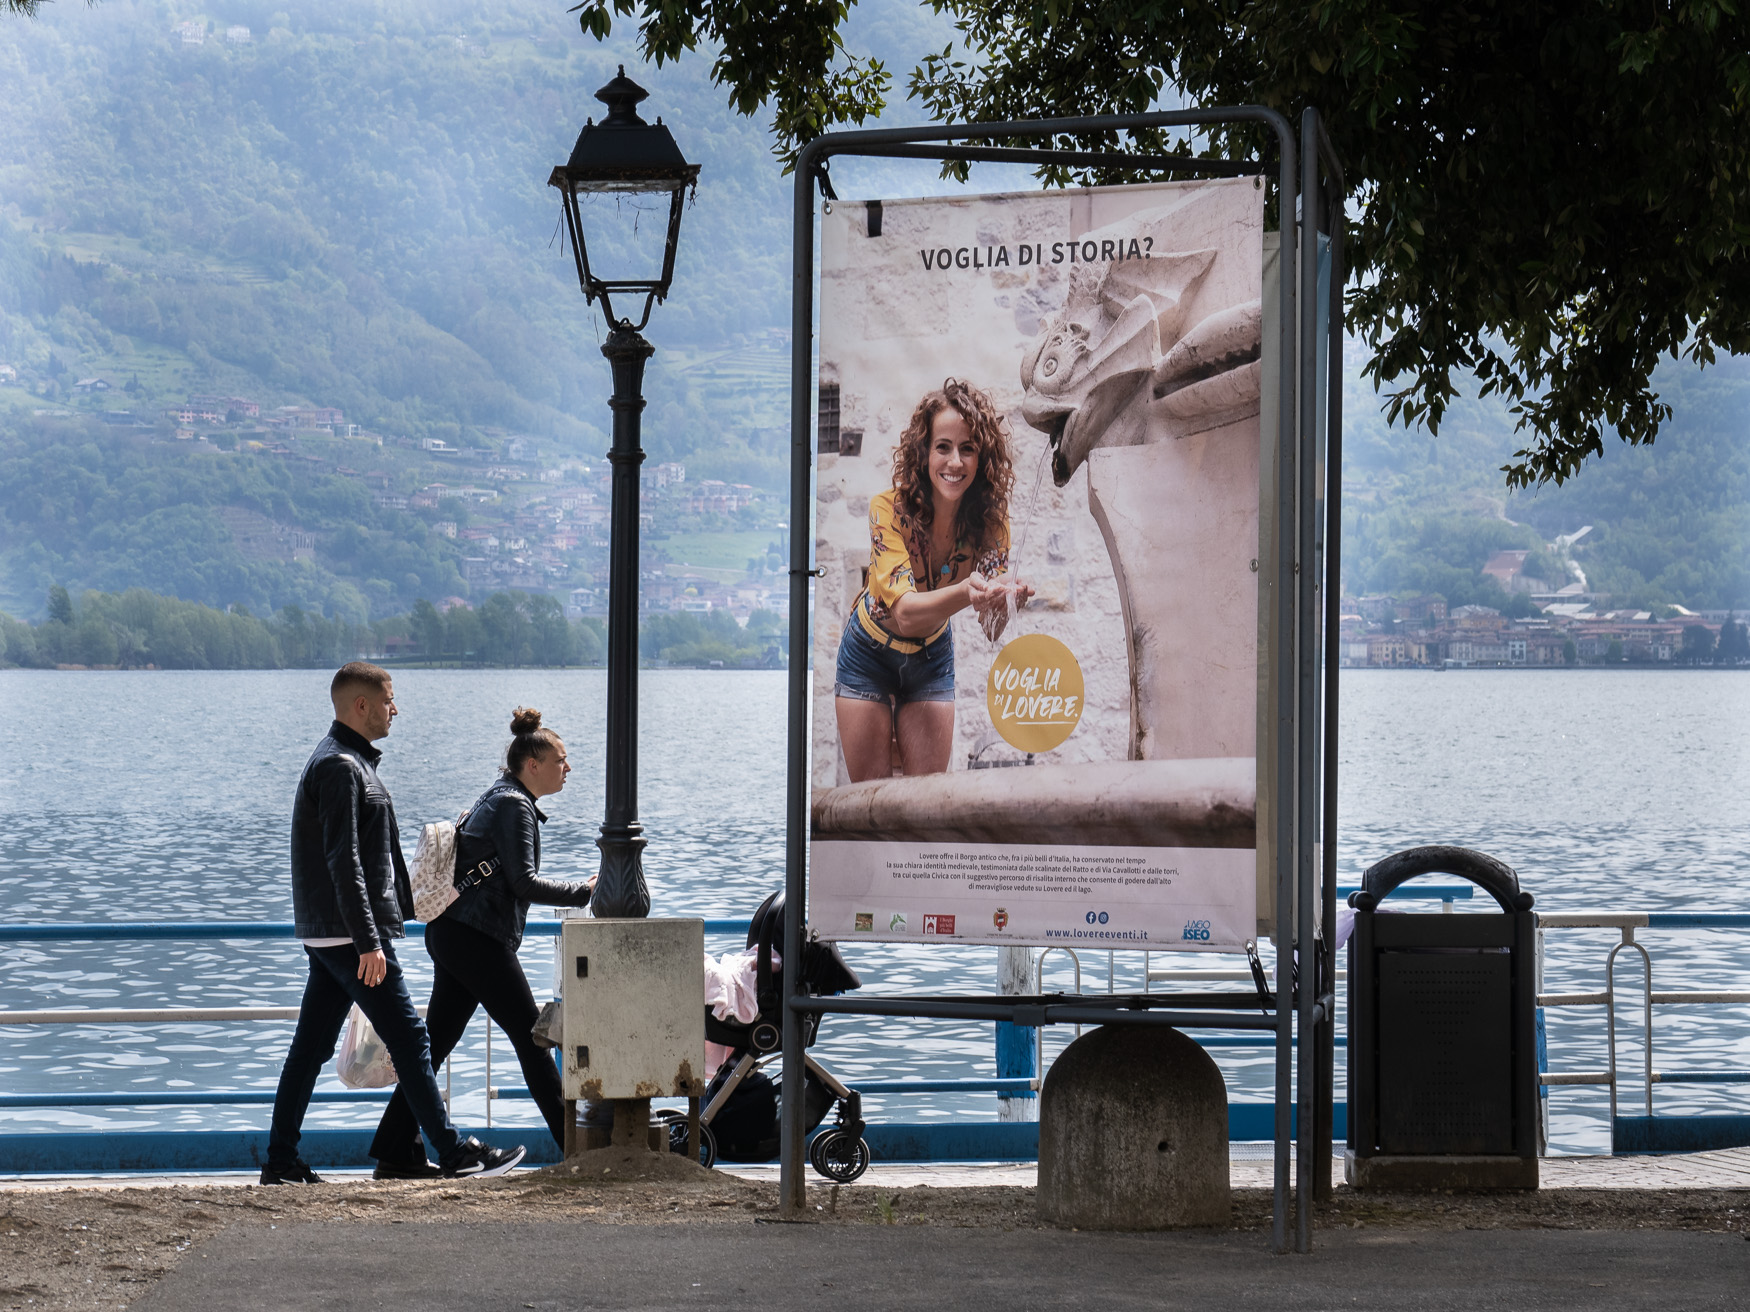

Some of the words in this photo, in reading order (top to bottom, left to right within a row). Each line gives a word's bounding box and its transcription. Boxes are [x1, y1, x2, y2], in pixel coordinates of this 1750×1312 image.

[920, 246, 1009, 271] VOGLIA
[1018, 243, 1042, 266] DI
[1051, 236, 1154, 264] STORIA?
[994, 662, 1061, 695] VOGLIA
[994, 693, 1004, 706] DI
[1001, 693, 1078, 720] LOVERE.
[998, 854, 1010, 862] che,
[1024, 855, 1033, 863] più
[948, 863, 980, 871] medievale,
[967, 874, 998, 882] suggestivo
[1125, 877, 1145, 885] godere
[976, 884, 1012, 892] meravigliose
[1078, 886, 1092, 894] lago.
[1046, 928, 1148, 940] www.lovereeventi.it
